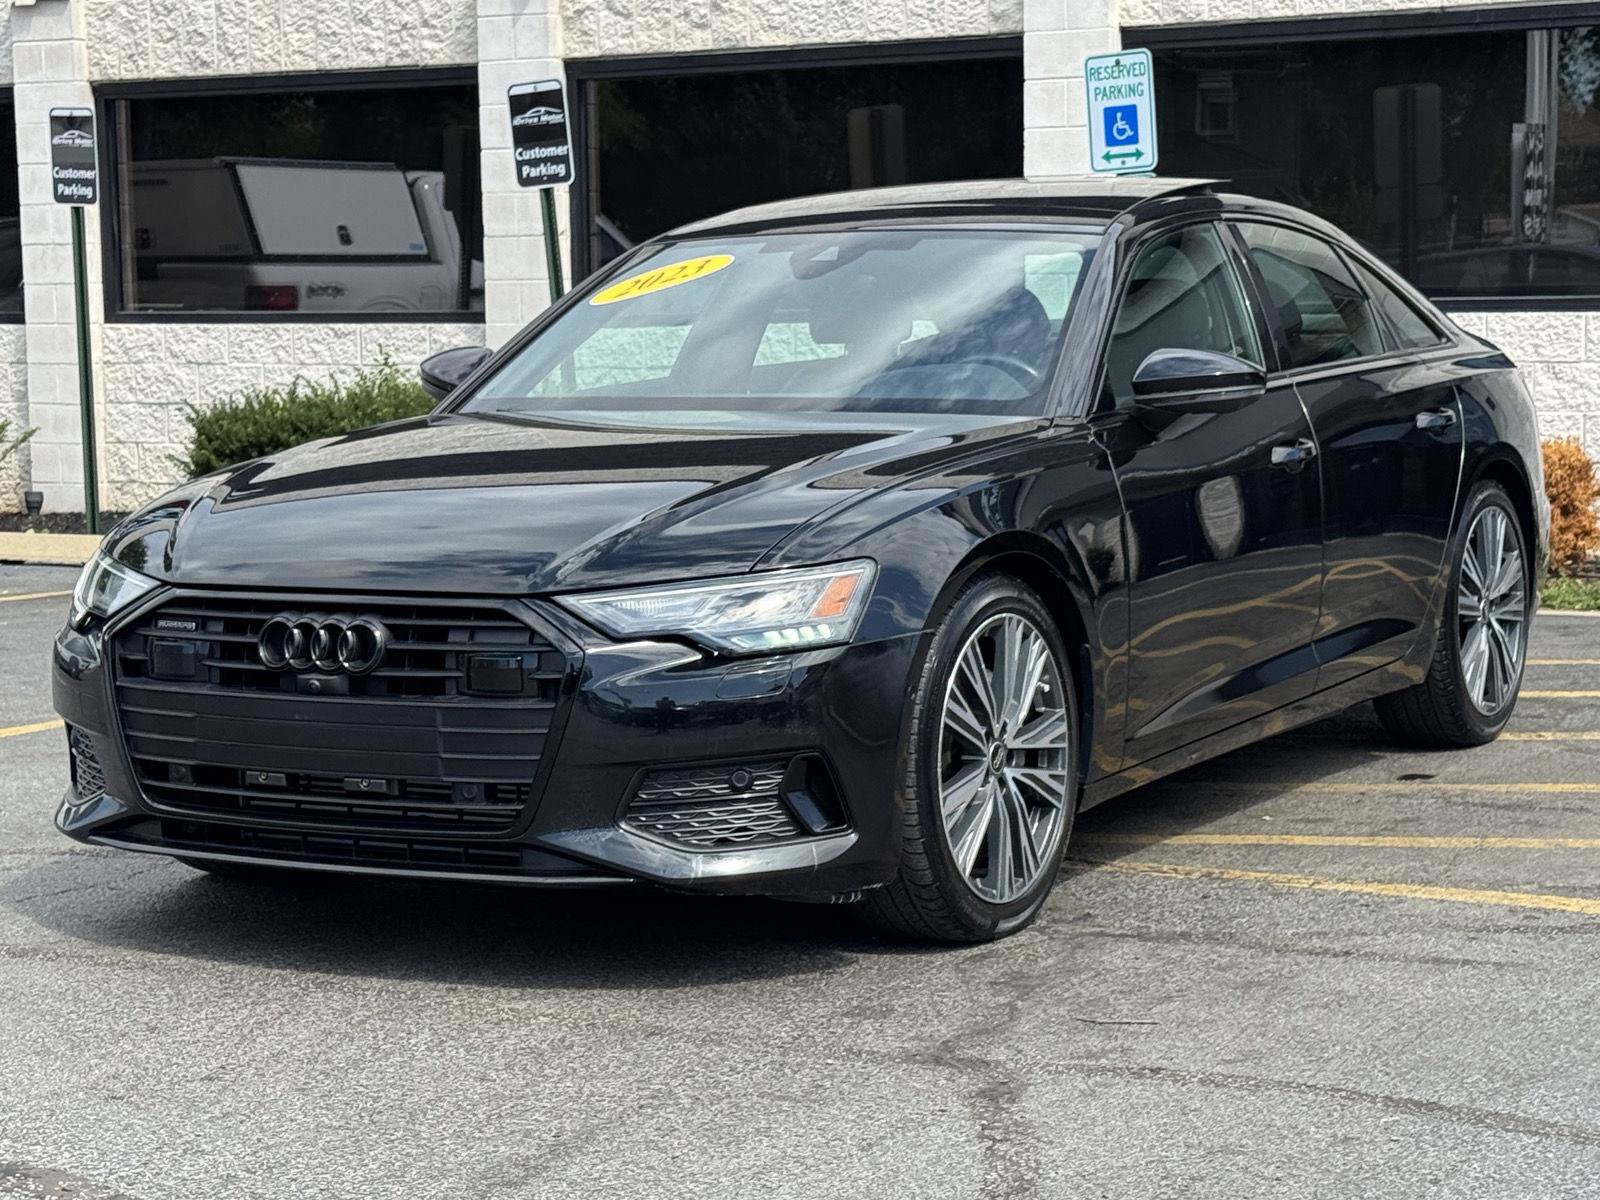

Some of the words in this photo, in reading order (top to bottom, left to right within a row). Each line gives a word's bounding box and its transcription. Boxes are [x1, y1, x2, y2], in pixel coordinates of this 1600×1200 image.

[1089, 62, 1146, 81] RESERVED
[1094, 83, 1144, 101] PARKING
[515, 145, 568, 161] Customer
[53, 166, 96, 179] Customer
[522, 162, 566, 179] Parking
[57, 183, 93, 199] Parking
